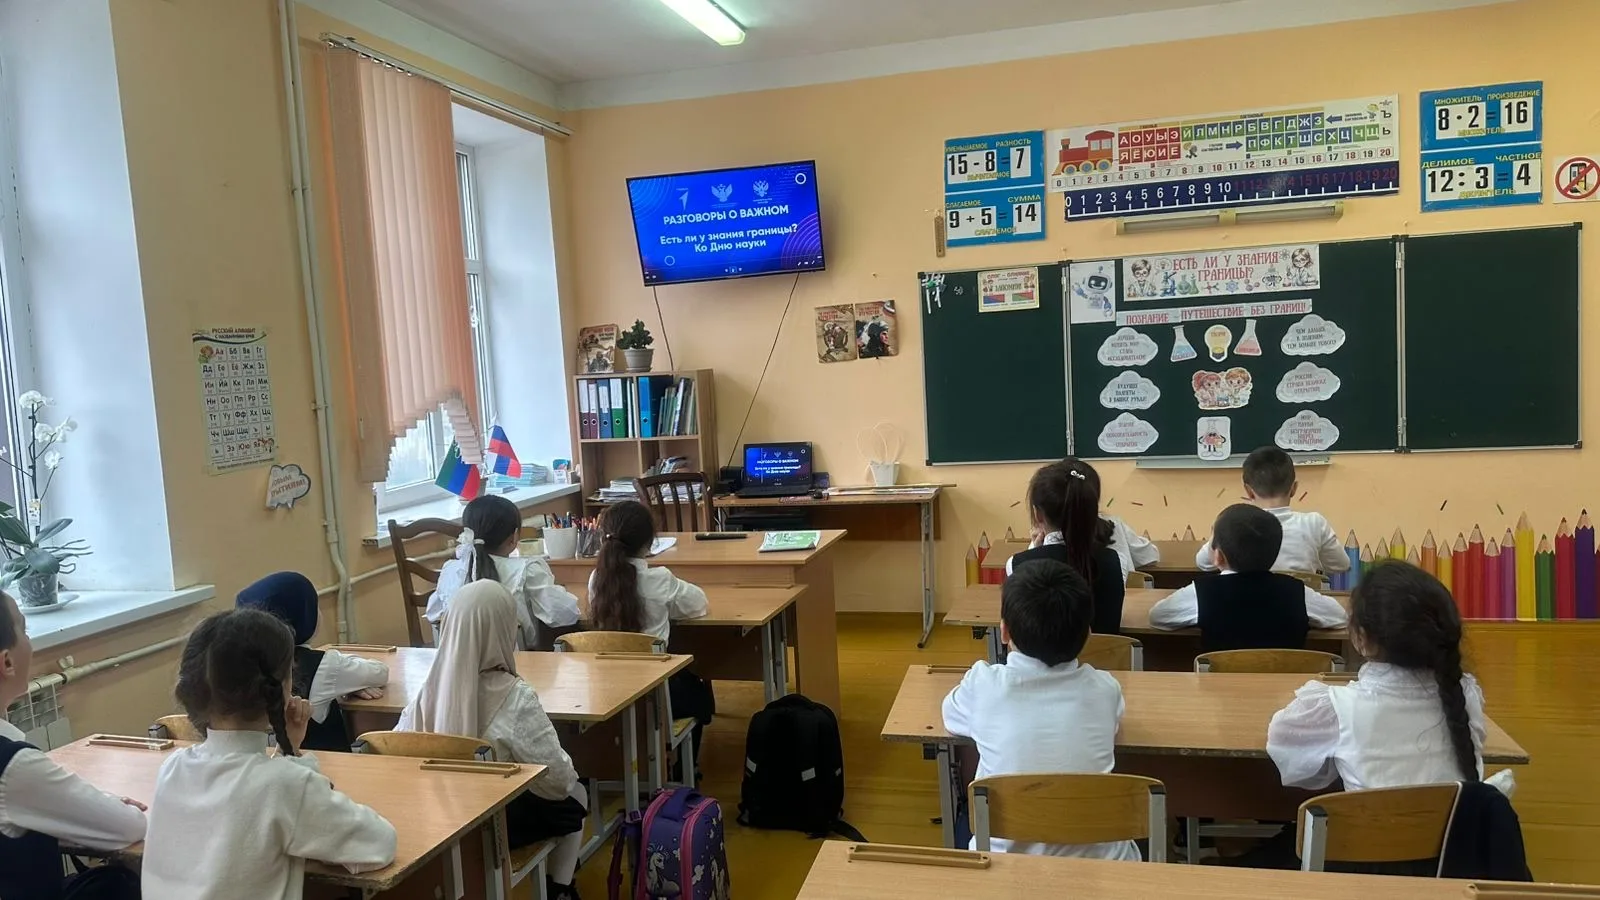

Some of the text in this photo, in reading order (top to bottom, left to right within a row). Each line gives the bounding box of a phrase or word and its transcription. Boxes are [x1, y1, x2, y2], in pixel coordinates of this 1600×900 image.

[1434, 89, 1540, 104] МНОЖИТЕЛЬ ПРОИЗВЕДЕНИЕ
[1438, 101, 1528, 130] 8 2 16
[996, 138, 1031, 147] РАЗНОСТЬ
[949, 148, 1024, 176] 15 8 7
[1422, 152, 1541, 168] ДЕЛИМОЕ ЧАСТНОЕ
[1428, 163, 1531, 192] 12 3 4
[946, 194, 1041, 208] СЛАГАЕМОЕ СУММА
[1065, 197, 1071, 207] 0
[1080, 195, 1085, 205] 1
[1096, 193, 1102, 204] 2
[1110, 192, 1117, 202] 3
[1125, 191, 1132, 200] 4
[1141, 189, 1148, 200] 5
[1157, 188, 1164, 198] 6
[1173, 186, 1179, 196] 7
[1188, 184, 1195, 195] 8
[1204, 183, 1211, 194] 9
[1218, 182, 1232, 193] 10
[663, 212, 726, 225] РАЗГОВОРЫ
[728, 210, 738, 218] О
[740, 205, 789, 218] ВАЖНОМ
[949, 204, 1036, 228] 9 5 14
[660, 224, 798, 245] Есть ли у знания границы?
[695, 240, 766, 253] Ко Дню науки
[1173, 252, 1279, 271] ЕСТЬ ЛИ У ЗНАНИЯ
[1198, 267, 1253, 282] ГРАНИЦЫ?
[1126, 313, 1169, 324] ПОЗНАНИЕ
[1181, 305, 1244, 319] ПУТЕШЕСТВИЕ
[1251, 305, 1266, 316] БЕЗ
